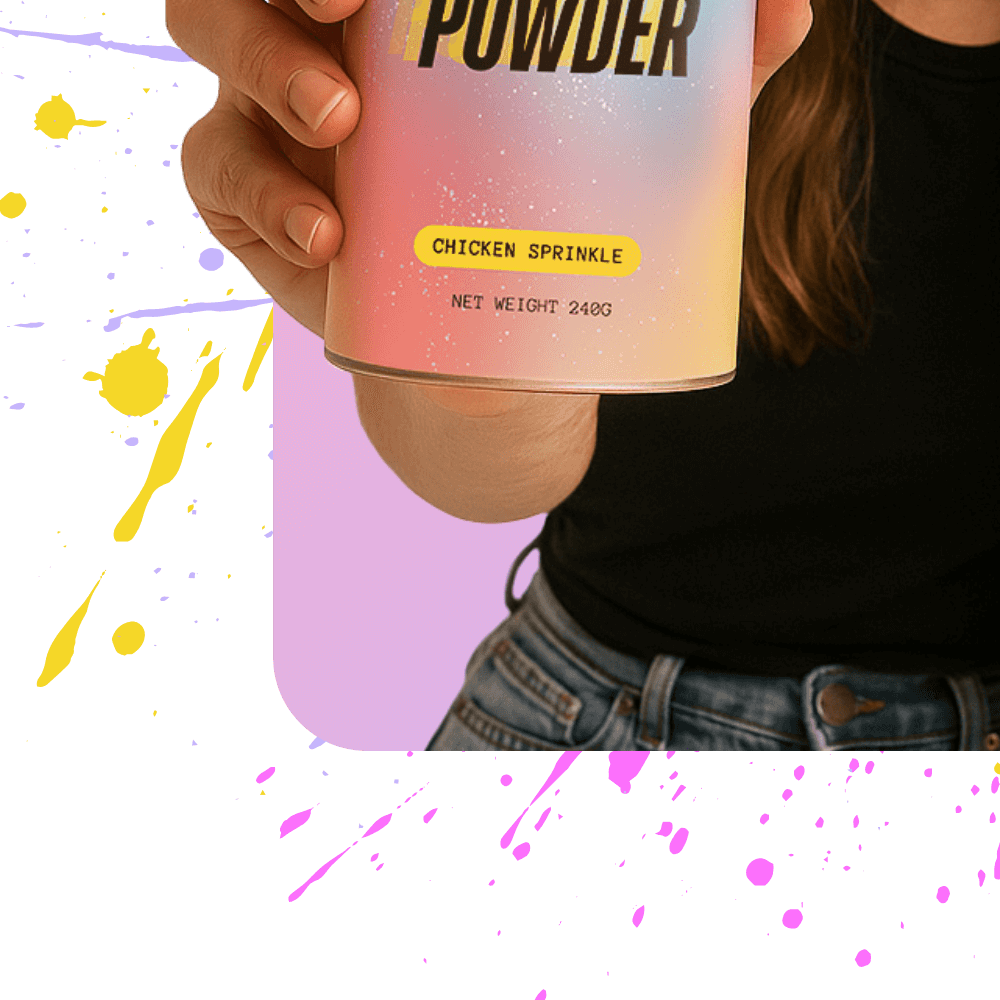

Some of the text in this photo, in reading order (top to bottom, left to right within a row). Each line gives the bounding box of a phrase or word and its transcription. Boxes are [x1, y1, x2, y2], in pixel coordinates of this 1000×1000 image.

[432, 237, 623, 264] CHICKEN SPRINKLE
[451, 294, 613, 317] NET WEIGHT 240G
